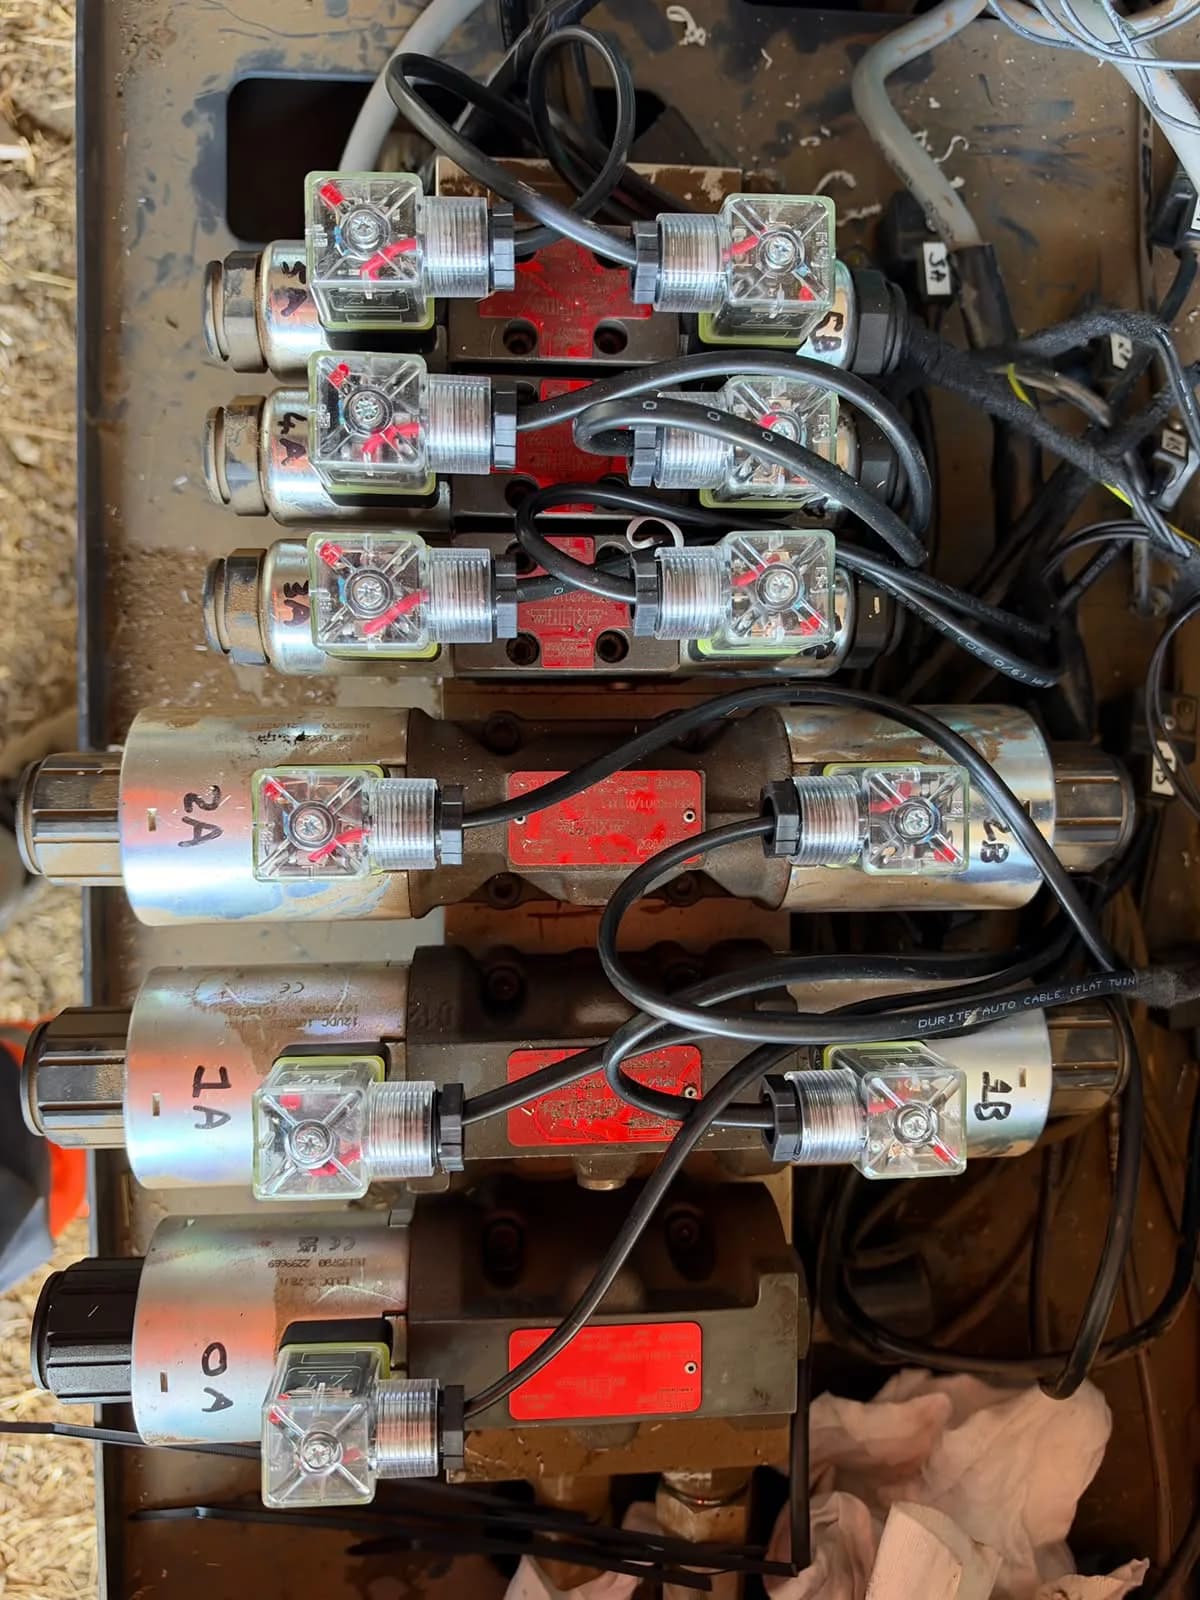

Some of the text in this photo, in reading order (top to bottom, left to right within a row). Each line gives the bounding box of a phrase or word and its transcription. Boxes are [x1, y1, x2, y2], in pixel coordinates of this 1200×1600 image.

[178, 785, 224, 847] 2A
[918, 1009, 972, 1029] DURITE
[982, 1000, 1016, 1016] AUTO
[1024, 990, 1062, 1006] CABLE
[192, 1065, 232, 1130] 1A
[974, 1071, 1013, 1121] 1B
